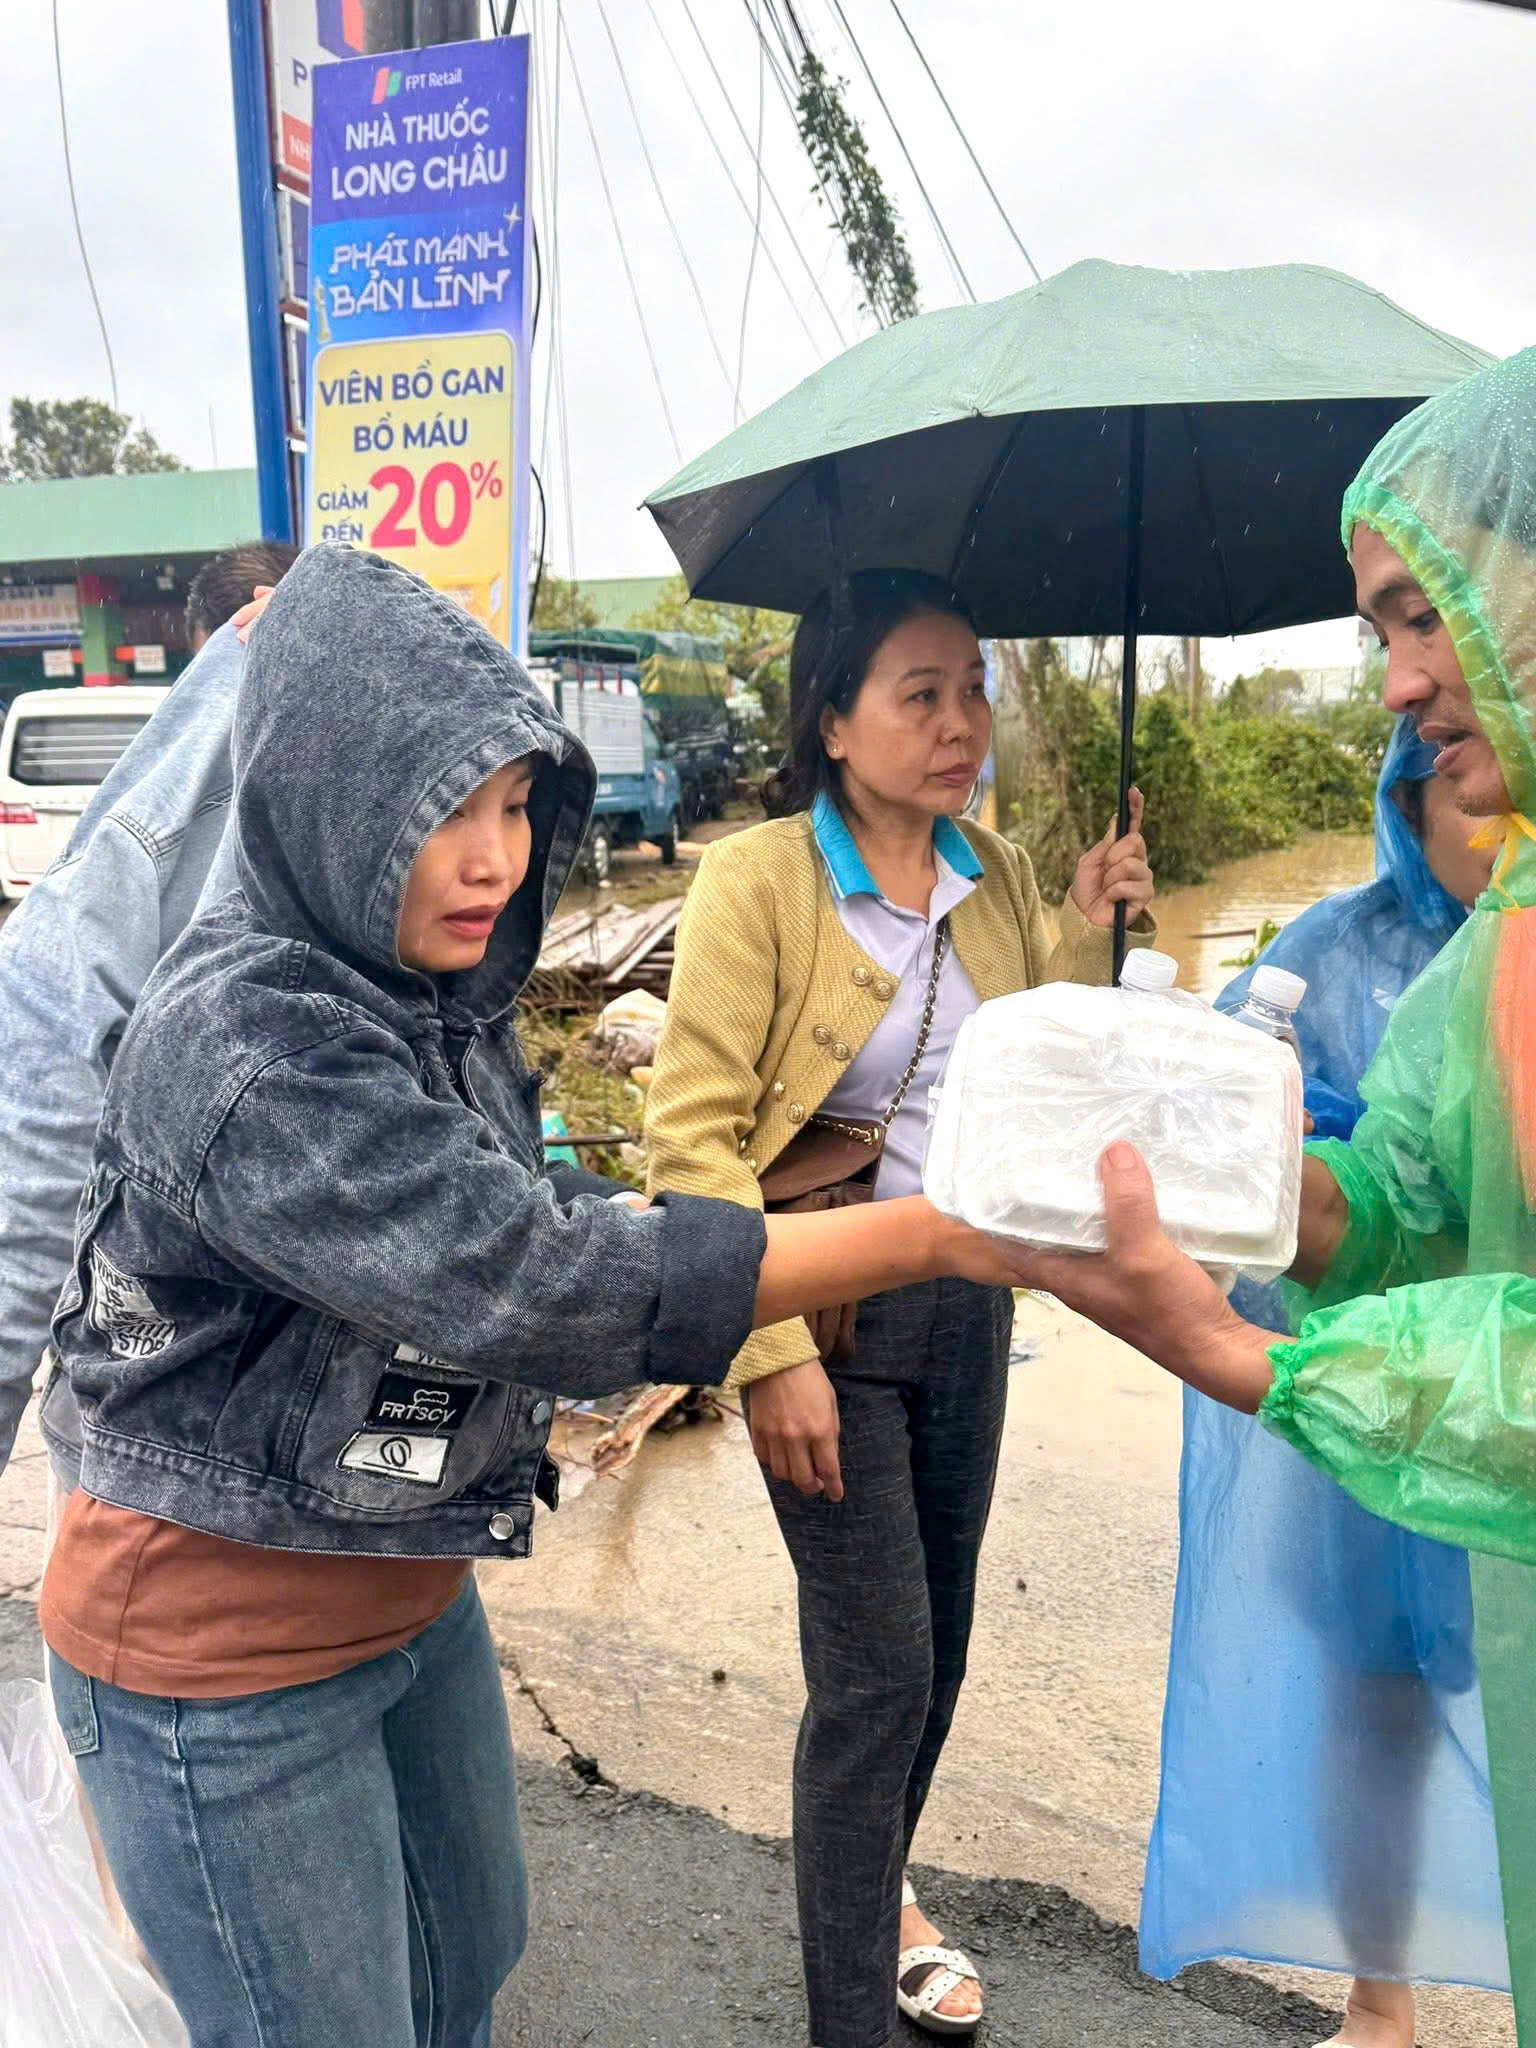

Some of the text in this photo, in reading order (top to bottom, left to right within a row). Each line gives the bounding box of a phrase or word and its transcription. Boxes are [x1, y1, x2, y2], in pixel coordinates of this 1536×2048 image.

[405, 67, 463, 92] FPT Retail
[345, 97, 489, 152] NHÀ THUỐC
[331, 143, 508, 200] LONG CHÂU
[329, 228, 510, 274] PHÁI MẠNH
[329, 266, 512, 318] BẢN LĨNH
[319, 360, 505, 407] VIÊN BỔ GAN
[353, 411, 468, 453] BỔ MÁU
[318, 483, 369, 511] GIẢM
[369, 460, 503, 549] 20%
[322, 515, 363, 542] ĐẾN
